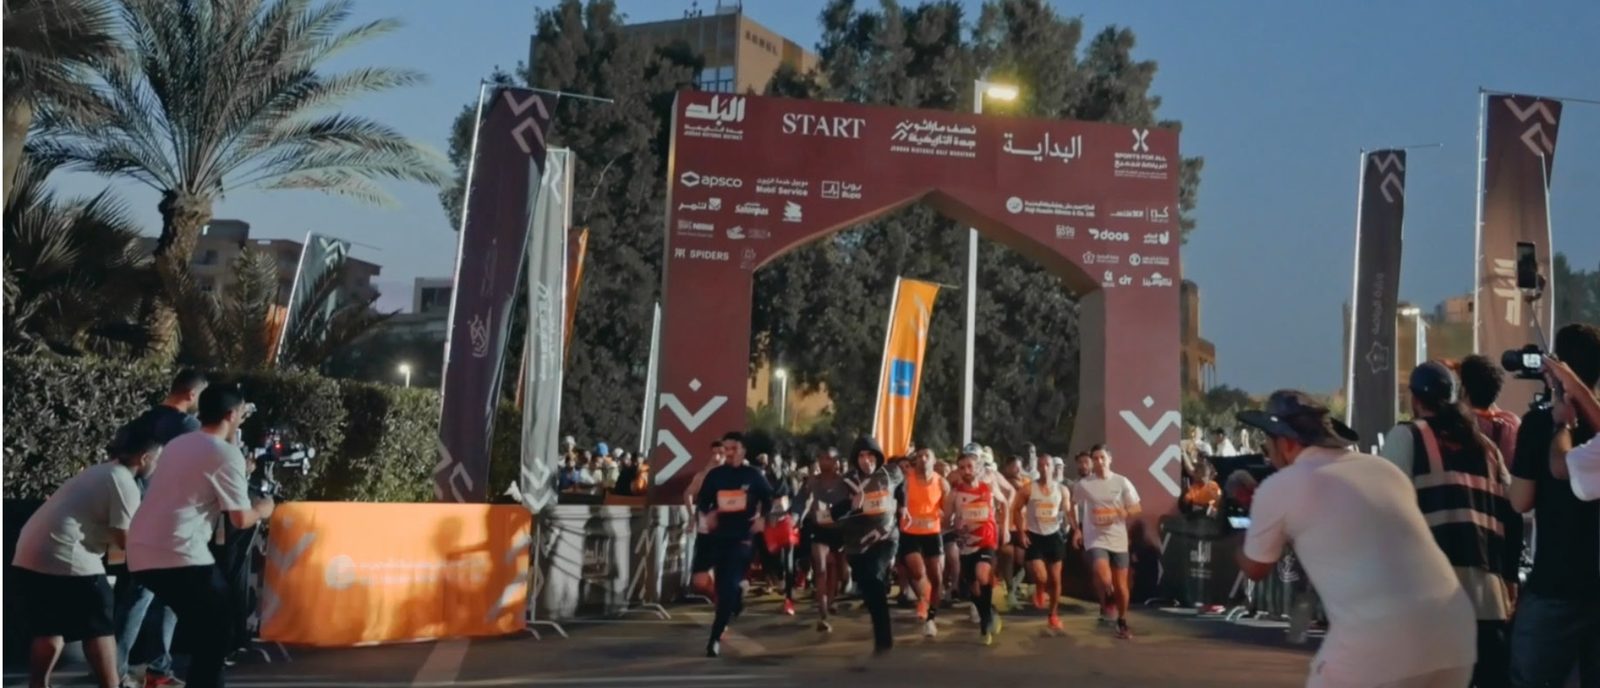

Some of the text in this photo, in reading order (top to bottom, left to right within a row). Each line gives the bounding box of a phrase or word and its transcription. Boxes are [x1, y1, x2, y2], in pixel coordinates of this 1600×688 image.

[782, 113, 866, 139] START
[1003, 132, 1082, 163] البداية
[701, 174, 743, 188] apsco
[778, 186, 808, 196] Service
[1100, 229, 1130, 241] doos
[689, 249, 729, 261] SPIDERS
